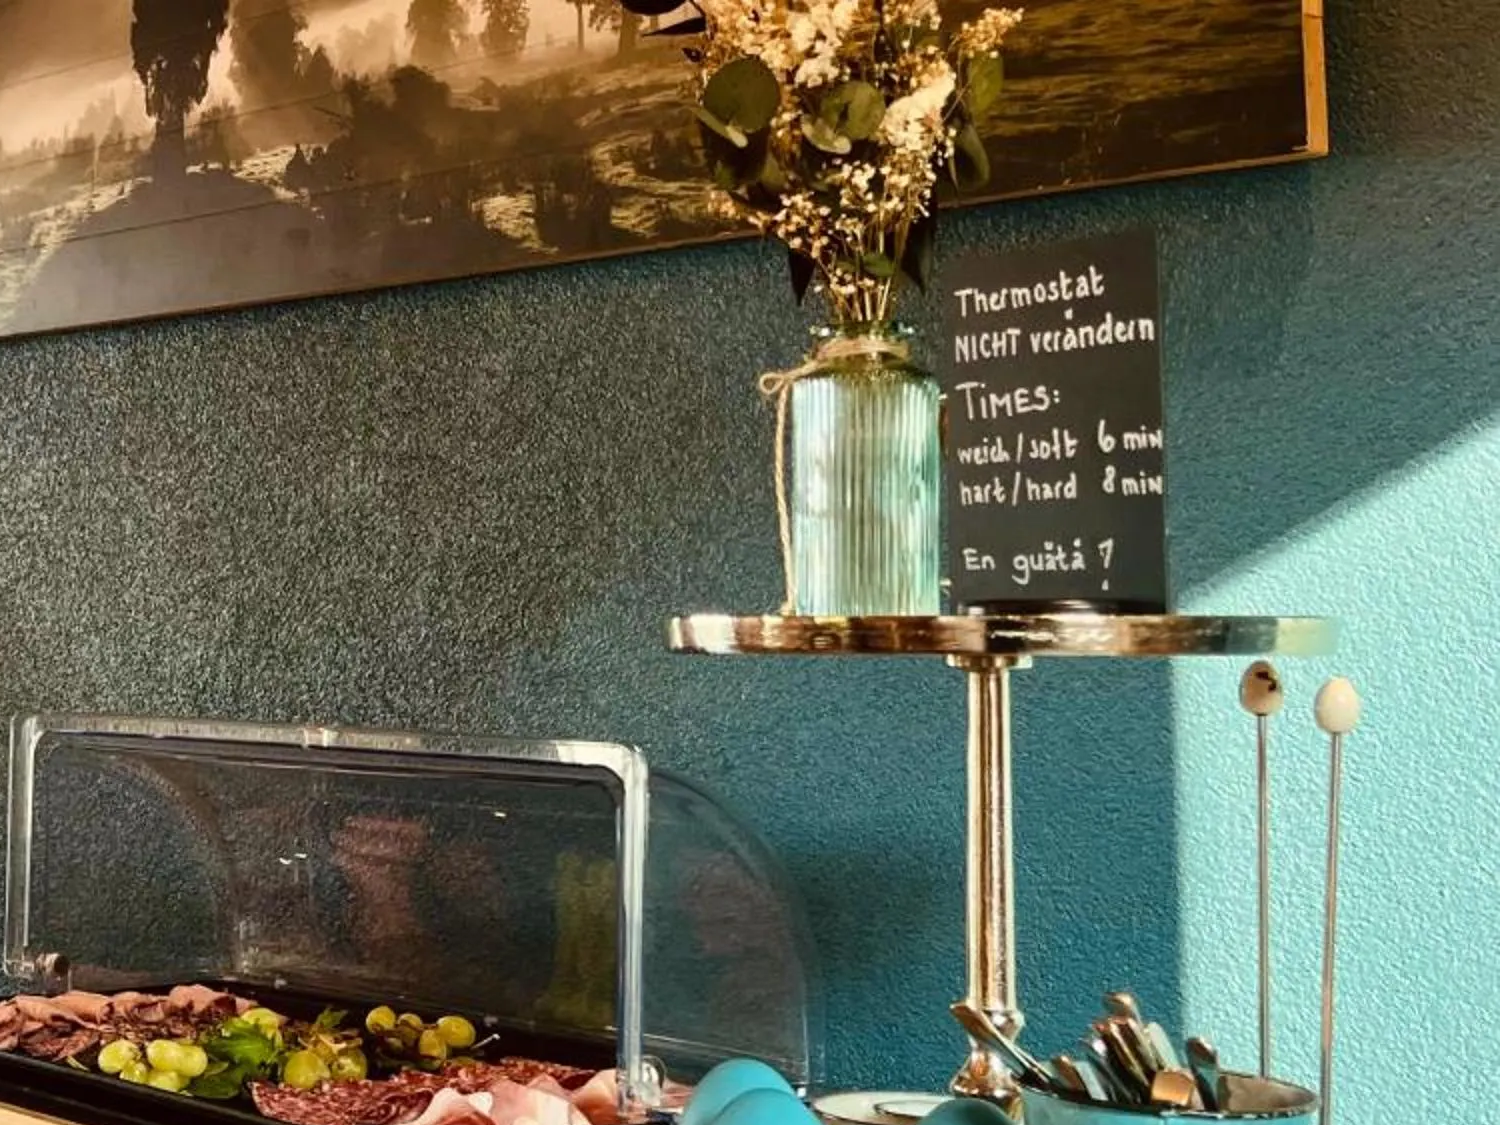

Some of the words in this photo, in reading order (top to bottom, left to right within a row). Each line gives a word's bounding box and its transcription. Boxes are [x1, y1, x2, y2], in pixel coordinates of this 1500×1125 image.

[954, 265, 1105, 318] Thermostat
[955, 328, 1022, 363] NICHT
[1098, 419, 1116, 452] 6
[1102, 465, 1116, 494] 8
[962, 547, 996, 571] En
